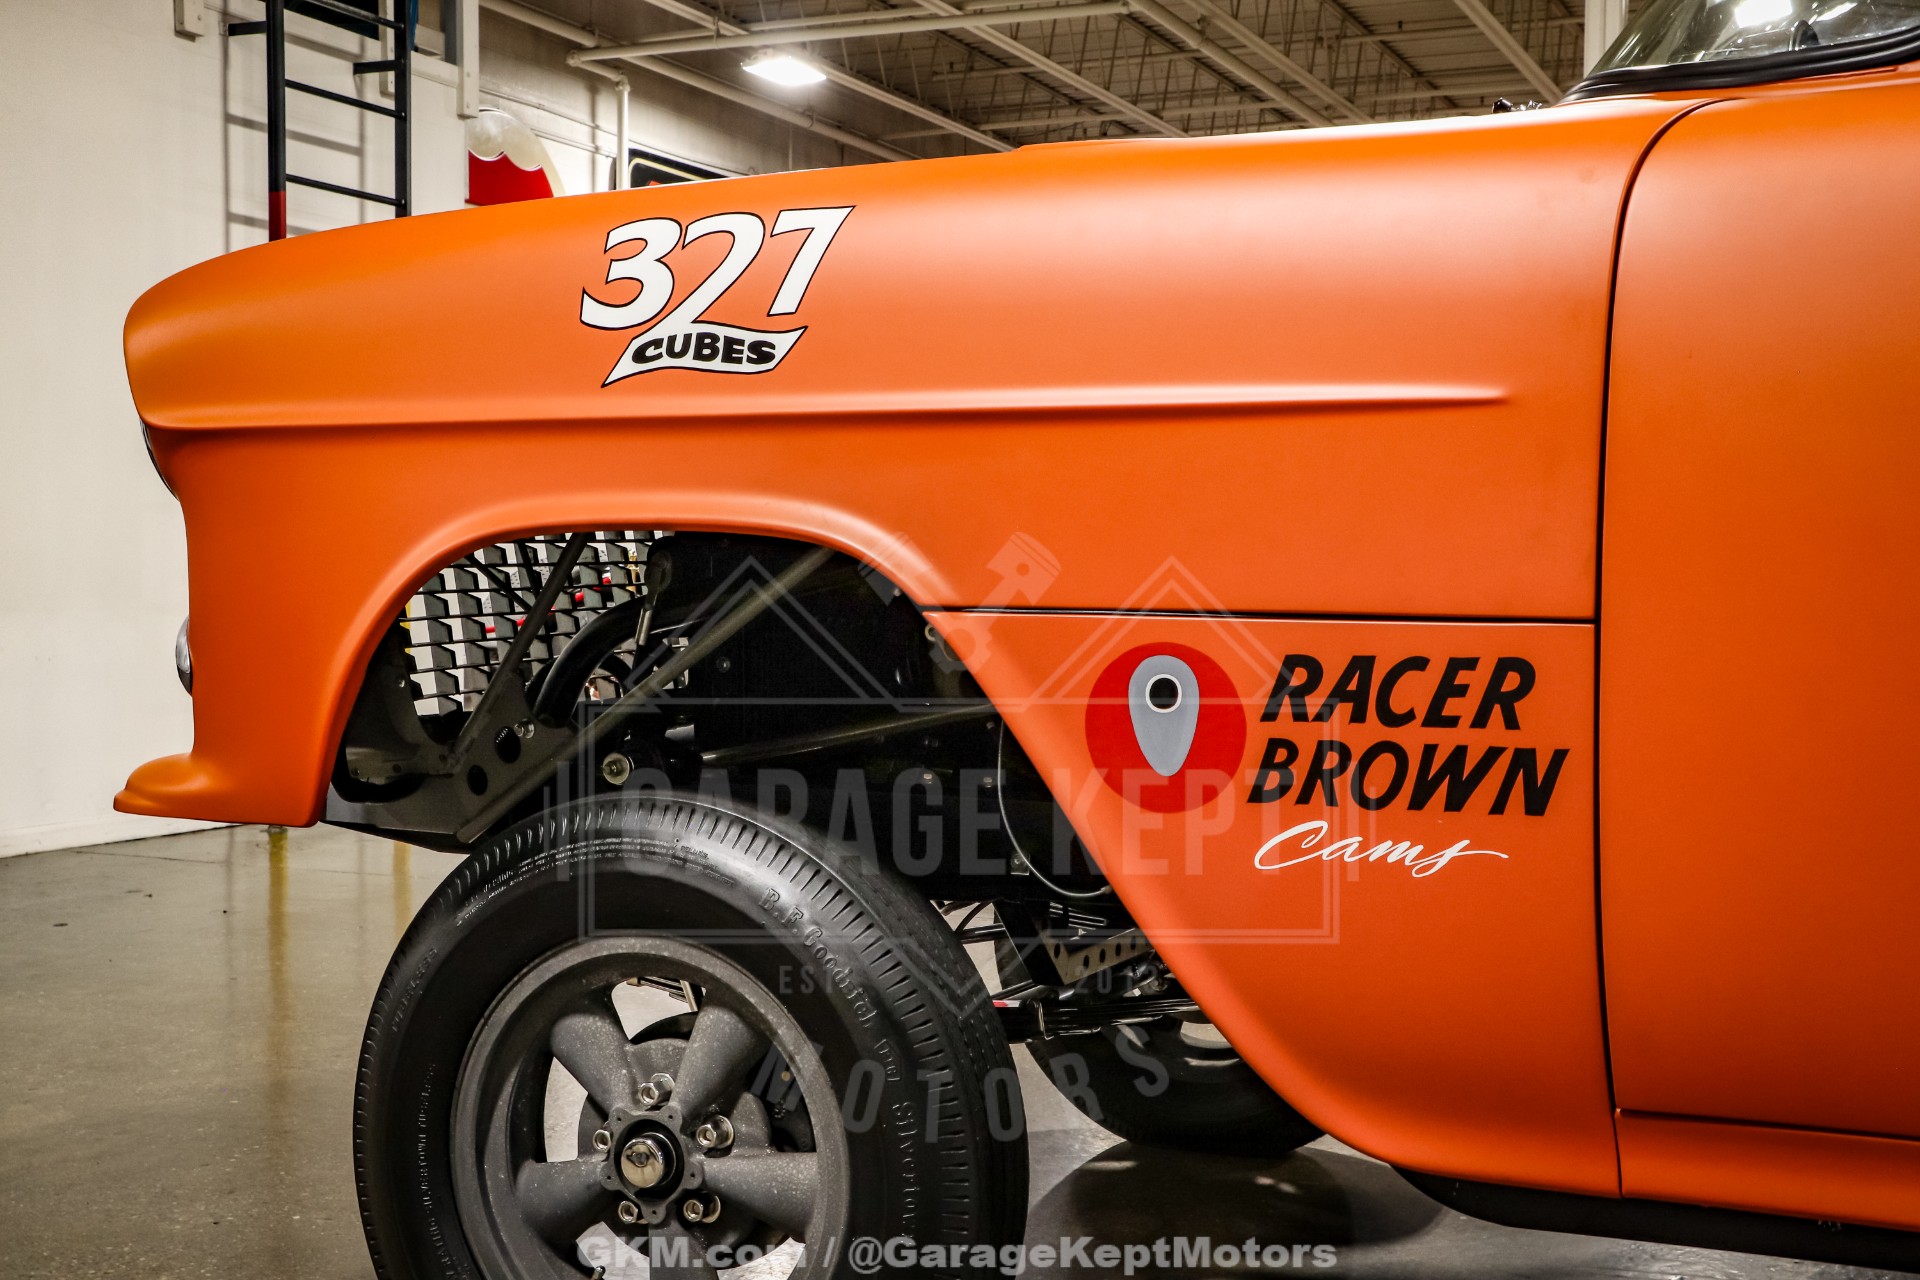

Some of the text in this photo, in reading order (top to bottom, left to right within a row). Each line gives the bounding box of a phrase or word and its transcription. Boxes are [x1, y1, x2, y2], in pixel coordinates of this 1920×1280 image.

[580, 205, 857, 331] 327
[631, 332, 776, 365] CUBES
[1259, 654, 1537, 731] RACER
[1246, 738, 1571, 817] BROWN
[1253, 820, 1510, 878] Cams
